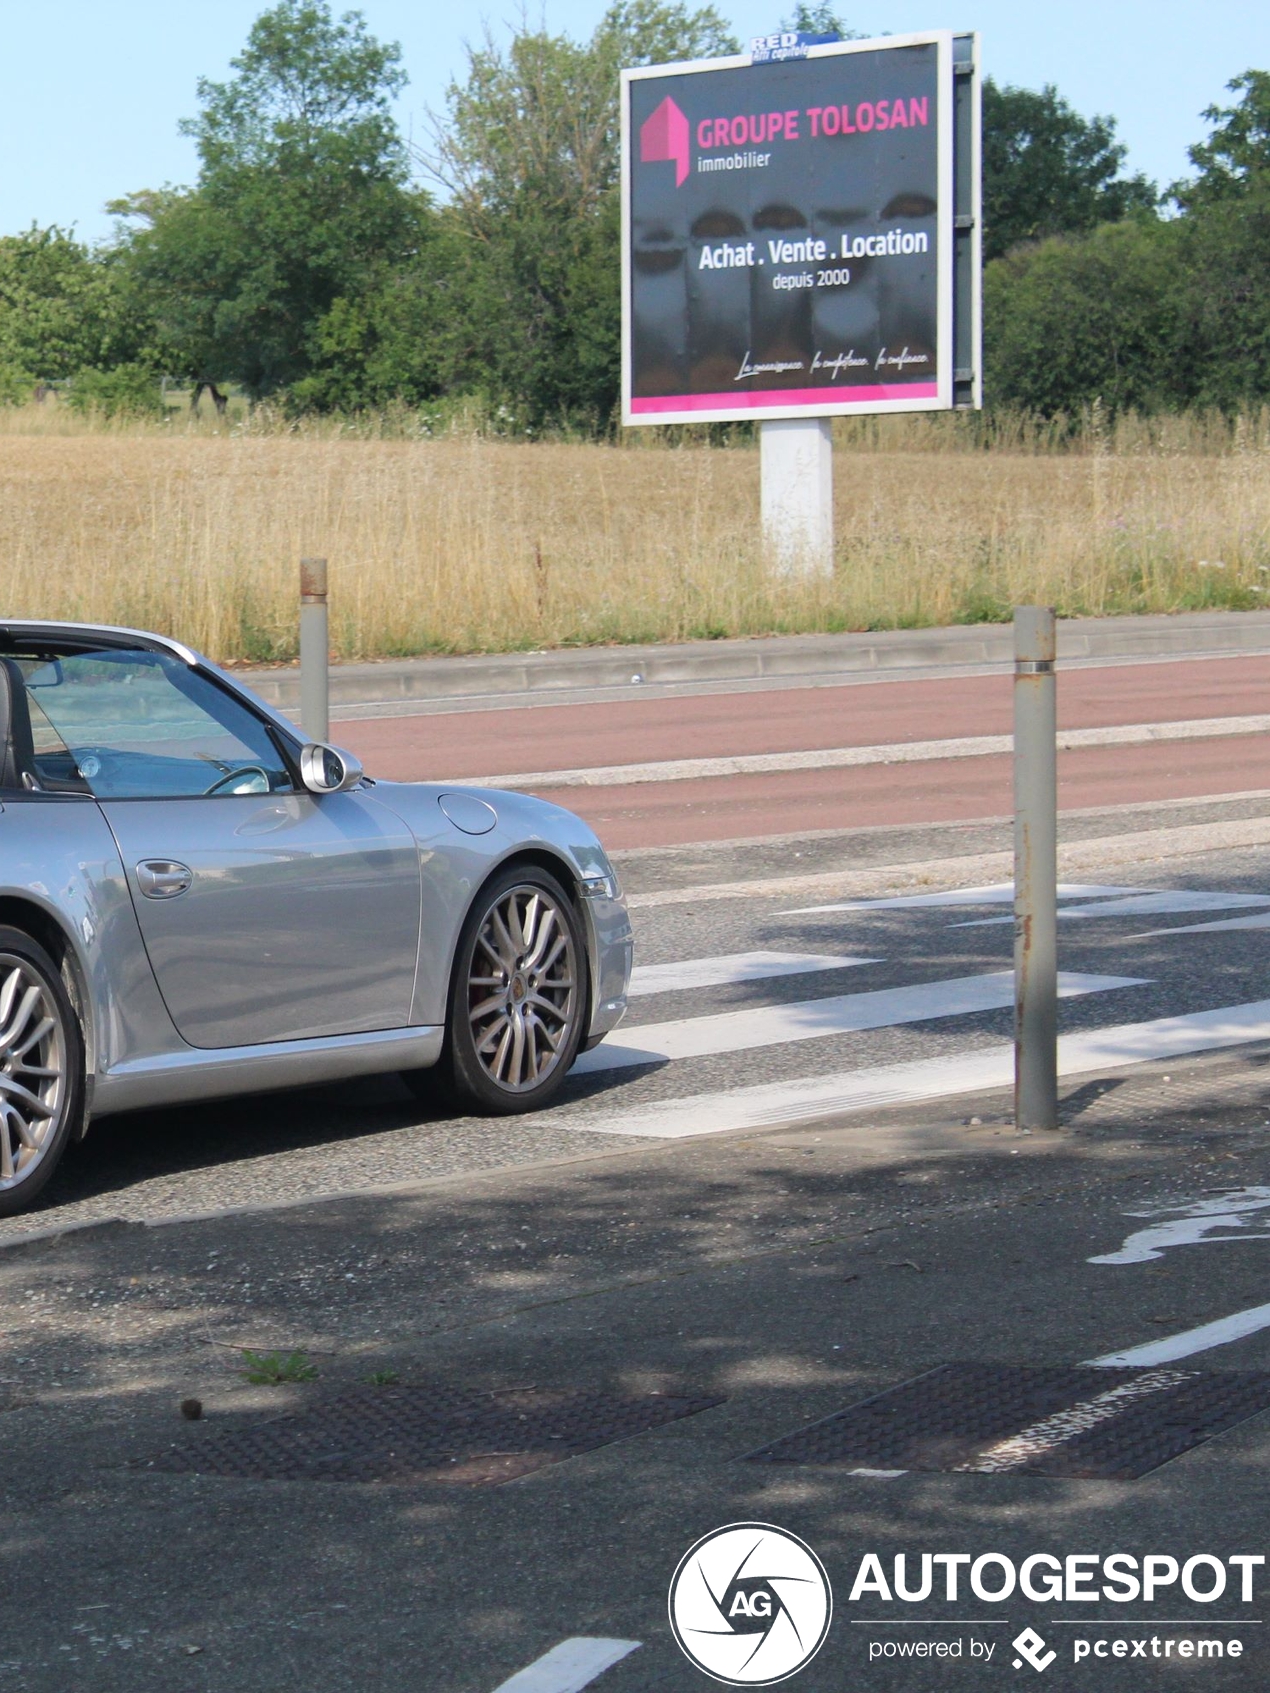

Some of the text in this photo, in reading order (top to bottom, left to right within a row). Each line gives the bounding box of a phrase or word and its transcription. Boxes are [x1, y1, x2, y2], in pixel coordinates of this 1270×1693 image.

[750, 33, 798, 51] RED
[697, 97, 928, 148] GROUPE TOLOSAN
[697, 151, 771, 173] immobilier
[699, 242, 755, 270] Achat
[769, 237, 826, 264] Vente
[841, 228, 928, 259] Location
[773, 268, 850, 291] depuis 2000
